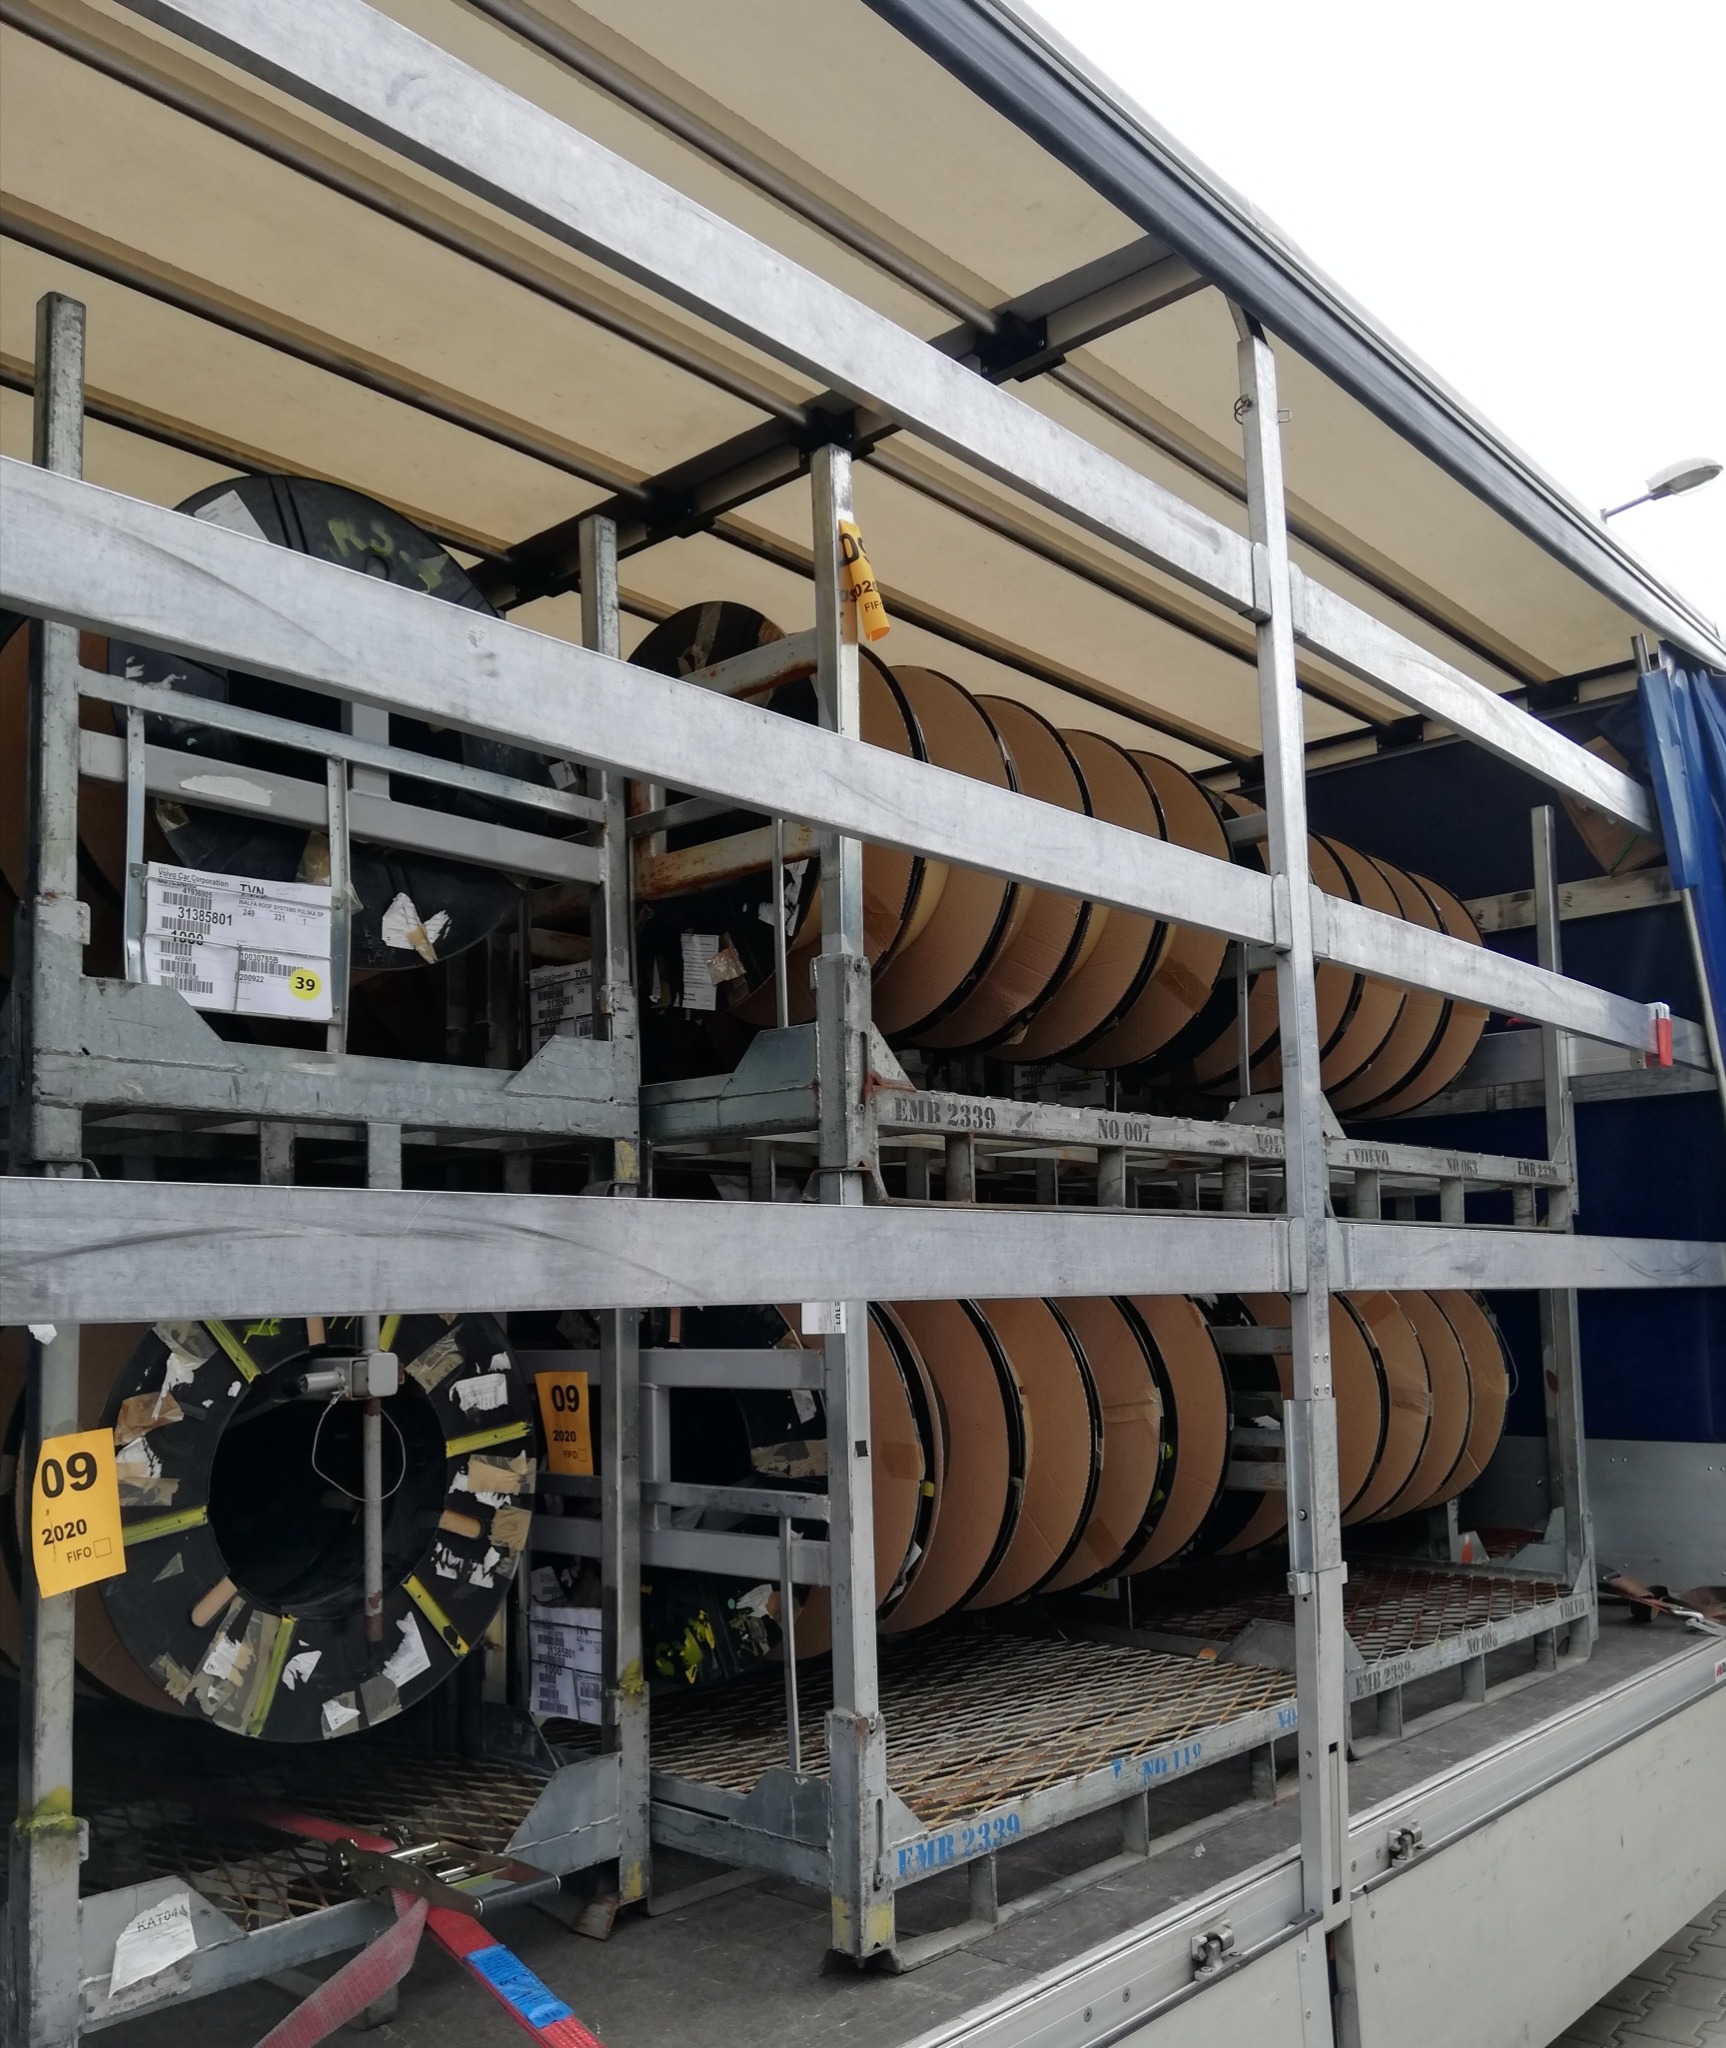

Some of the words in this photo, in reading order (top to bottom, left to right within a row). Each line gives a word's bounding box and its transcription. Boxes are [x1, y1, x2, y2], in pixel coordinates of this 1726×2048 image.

[158, 867, 176, 878] Volvo
[178, 872, 190, 880] Car
[191, 874, 229, 887] Corporation
[239, 883, 266, 898] TVN
[178, 906, 232, 926] 31385801
[242, 908, 255, 917] 249
[273, 913, 285, 922] 331
[294, 976, 316, 991] 39
[947, 1103, 996, 1130] 2339
[1097, 1118, 1120, 1140] NO
[1123, 1121, 1151, 1144] 007
[1446, 1158, 1460, 1174] NO
[551, 1384, 580, 1413] 09
[553, 1429, 577, 1443] 2020
[563, 1449, 578, 1460] FIFO
[41, 1451, 98, 1499] 09
[41, 1518, 88, 1546] 2020
[66, 1546, 92, 1564] FIFO
[1559, 1598, 1586, 1620] VOLVO
[1466, 1635, 1480, 1655] NO
[1383, 1660, 1412, 1686] 2339
[1142, 1754, 1168, 1787] NO
[961, 1813, 1021, 1858] 2339
